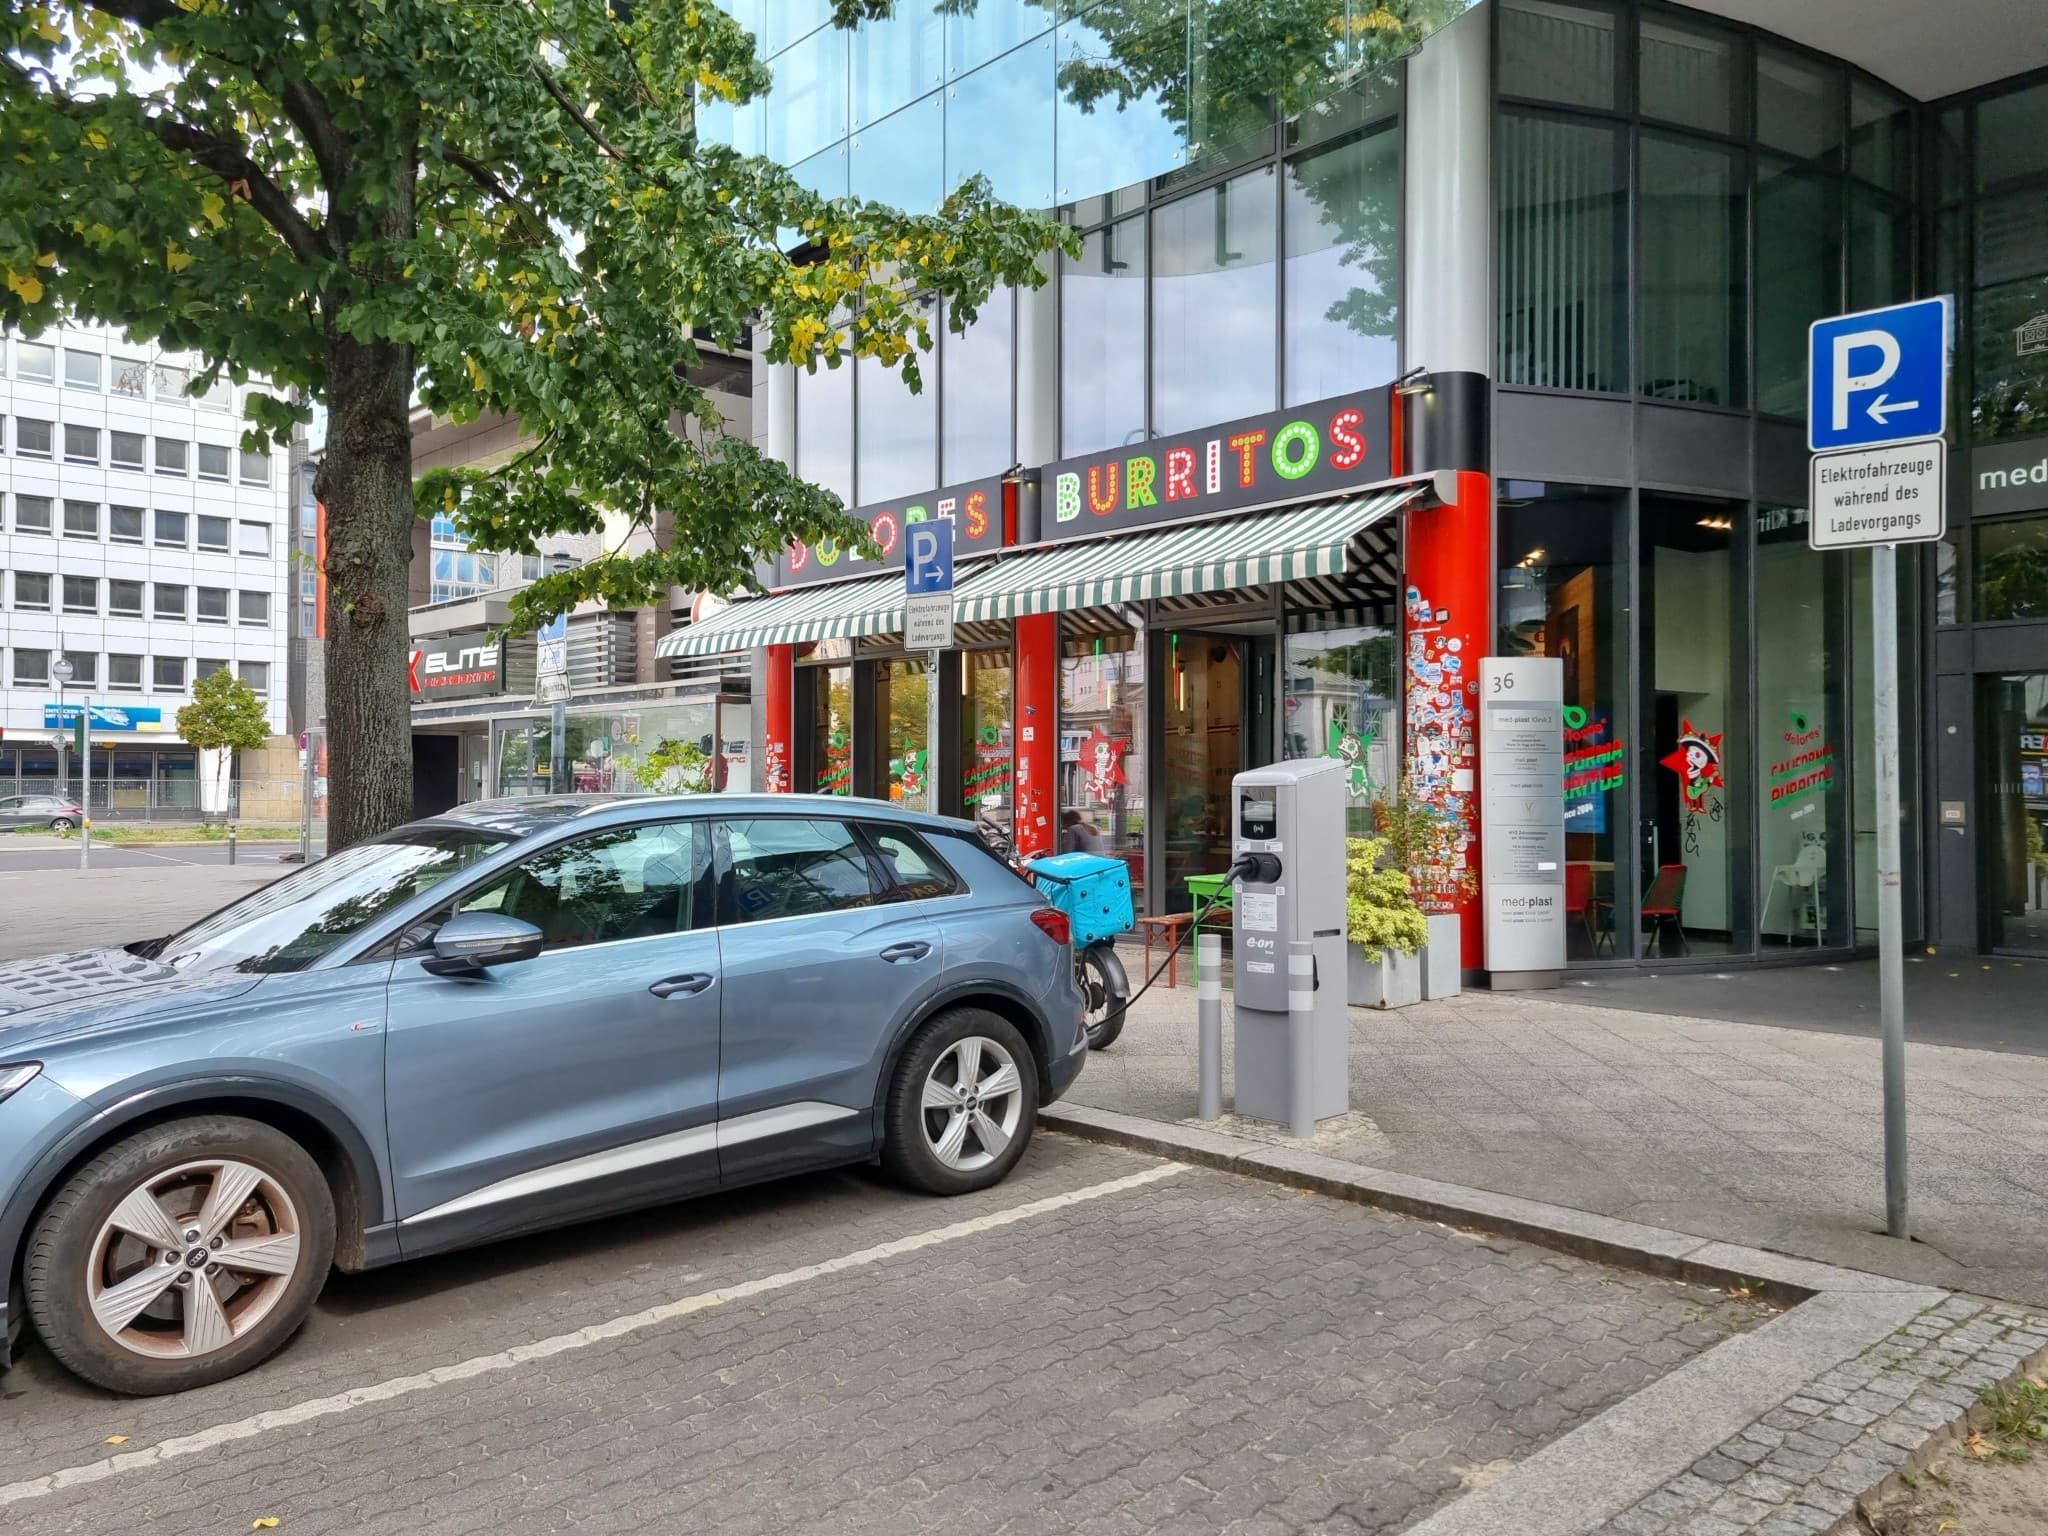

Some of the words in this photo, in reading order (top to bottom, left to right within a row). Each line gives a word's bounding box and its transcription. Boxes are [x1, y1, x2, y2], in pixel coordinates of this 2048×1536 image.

[1832, 329, 1901, 431] P
[1056, 409, 1367, 523] BURRITOS
[1820, 458, 1934, 484] Elektrofahrzeuge
[1834, 484, 1889, 507] während
[1895, 484, 1919, 501] des
[1831, 511, 1921, 534] Ladevorgangs
[912, 531, 938, 585] P
[1492, 672, 1514, 694] 36
[1784, 728, 1820, 746] dolores
[1501, 896, 1553, 909] med-plast
